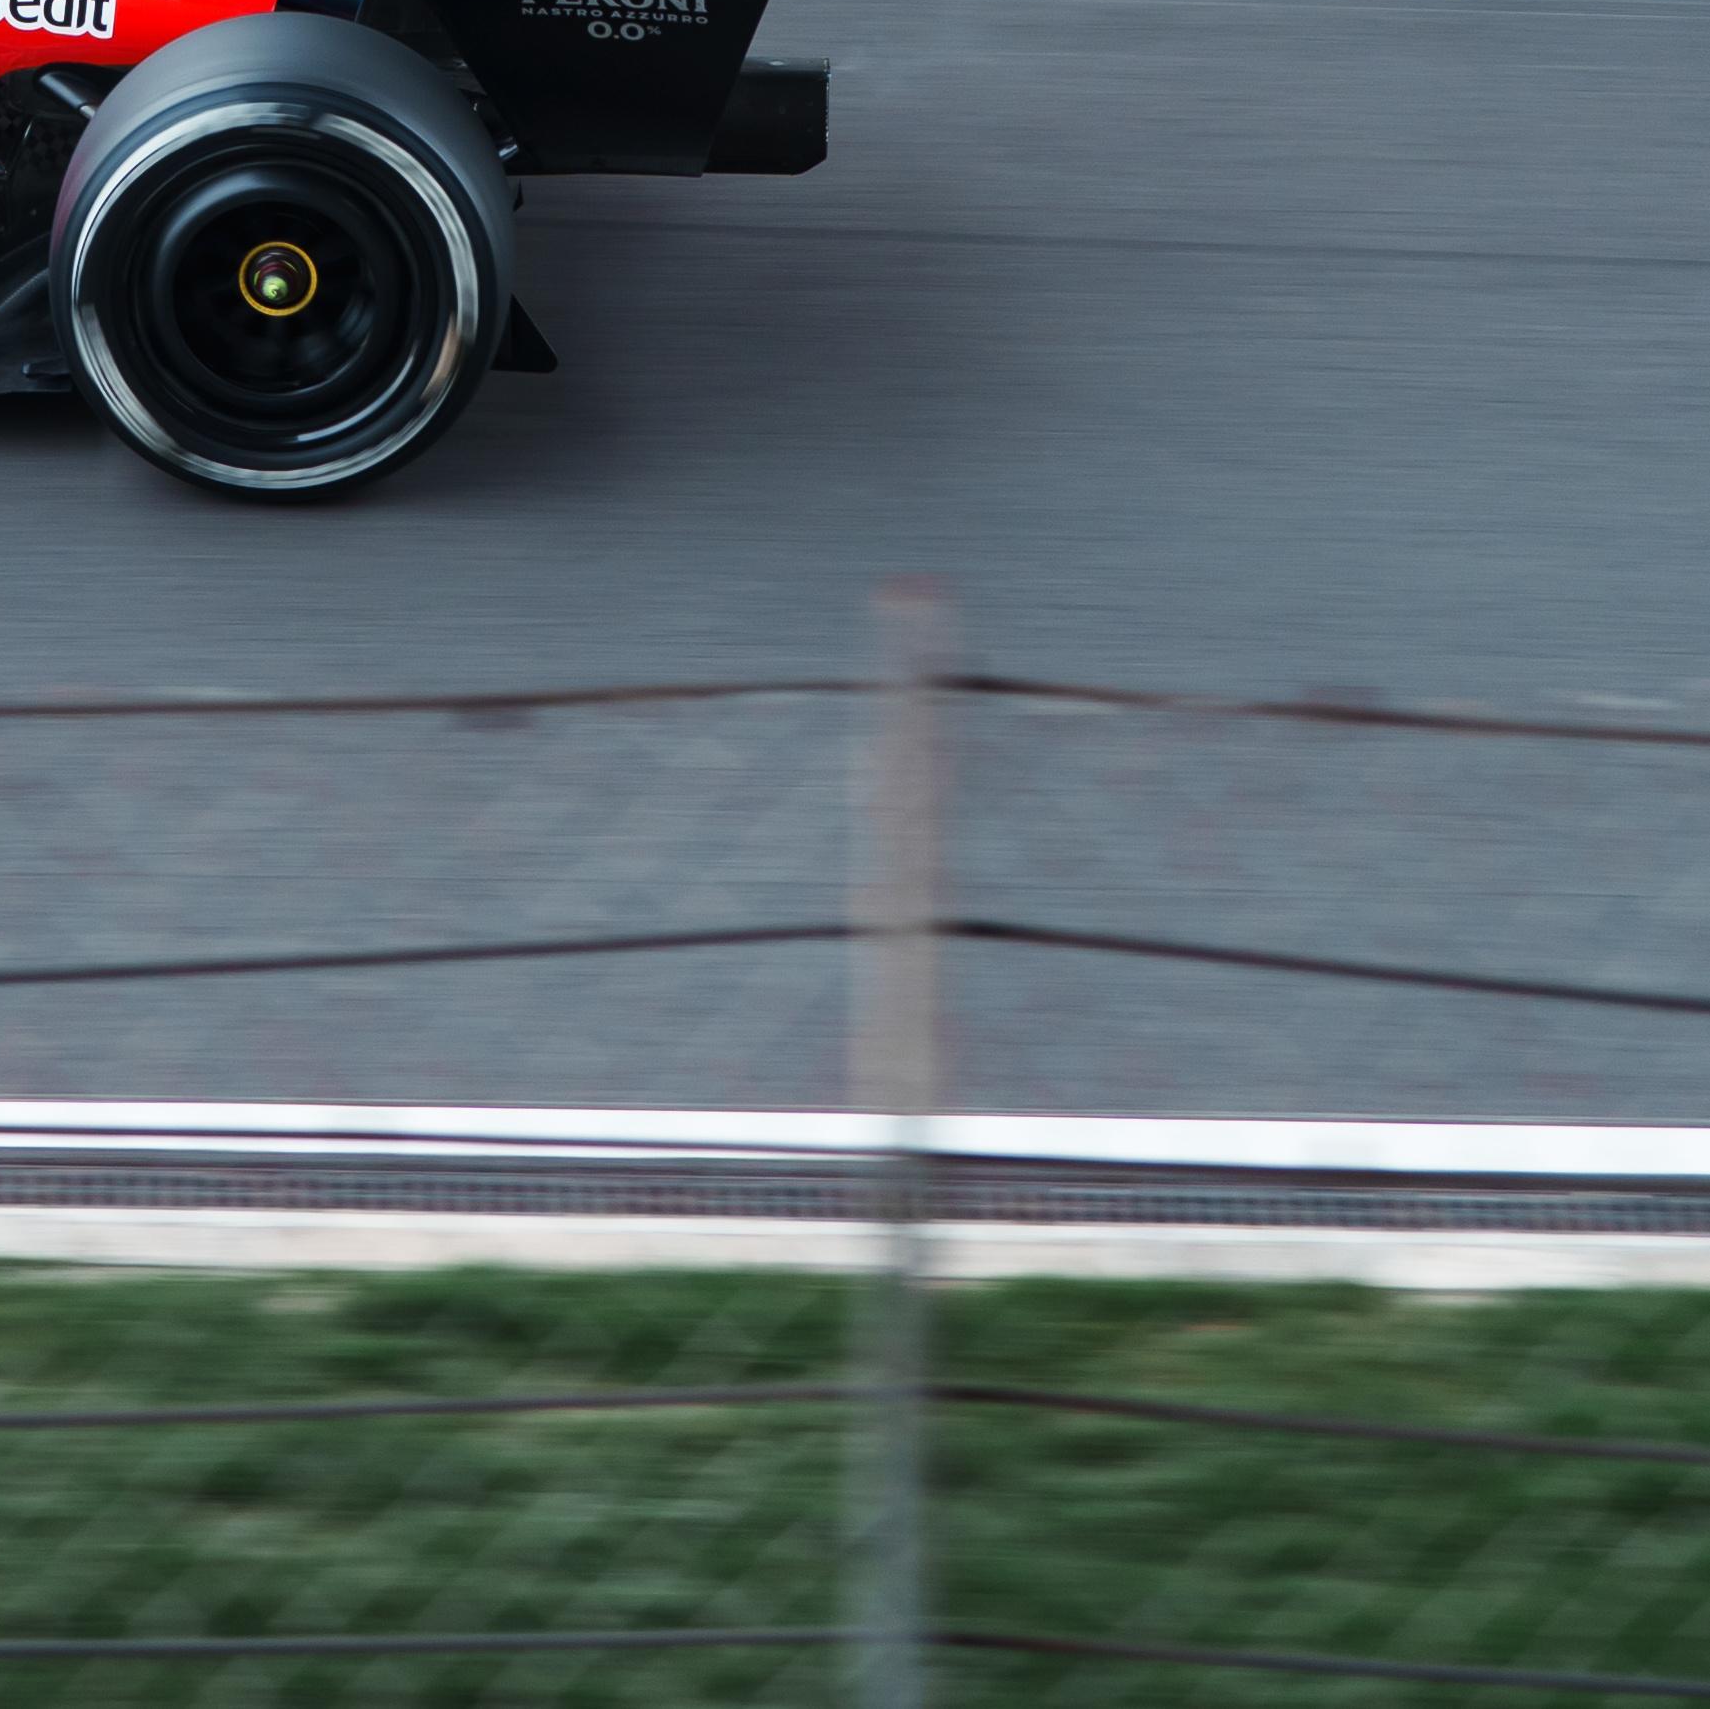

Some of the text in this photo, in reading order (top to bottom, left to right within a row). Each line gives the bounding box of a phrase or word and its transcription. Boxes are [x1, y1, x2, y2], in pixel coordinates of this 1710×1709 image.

[521, 6, 709, 25] NASTRO AZZURRO
[586, 20, 663, 41] 0.0%
